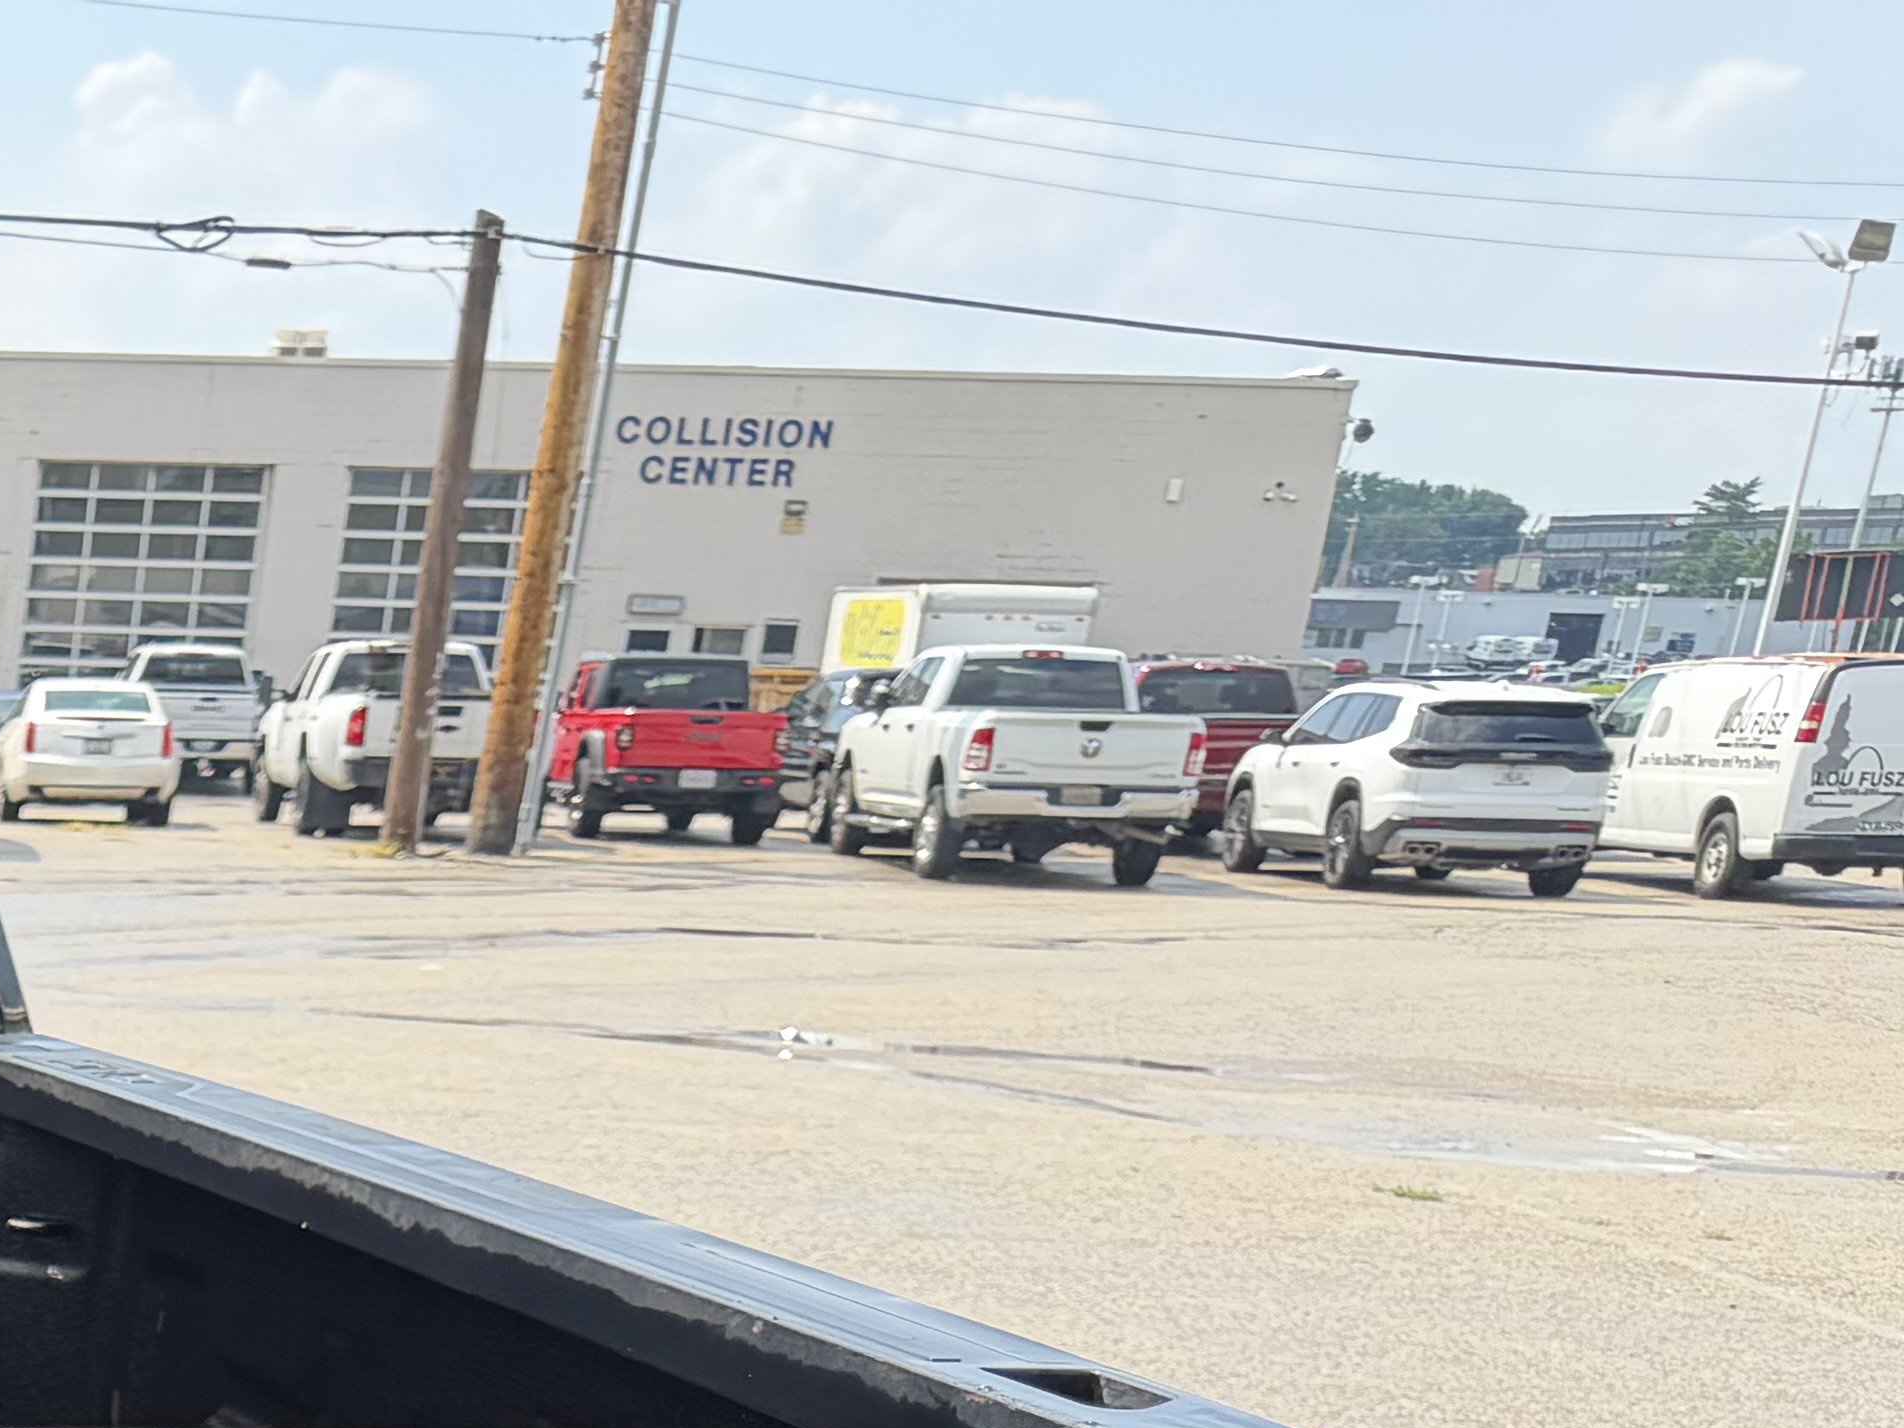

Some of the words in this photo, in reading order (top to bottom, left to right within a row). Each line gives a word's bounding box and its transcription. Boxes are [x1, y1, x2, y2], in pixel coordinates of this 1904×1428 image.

[615, 414, 834, 449] COLLISION
[638, 454, 796, 488] CENTER
[1720, 711, 1753, 734] LOU
[1753, 711, 1790, 736] FUSZ
[1813, 770, 1854, 787] LOU
[1858, 770, 1904, 788] FUSZ
